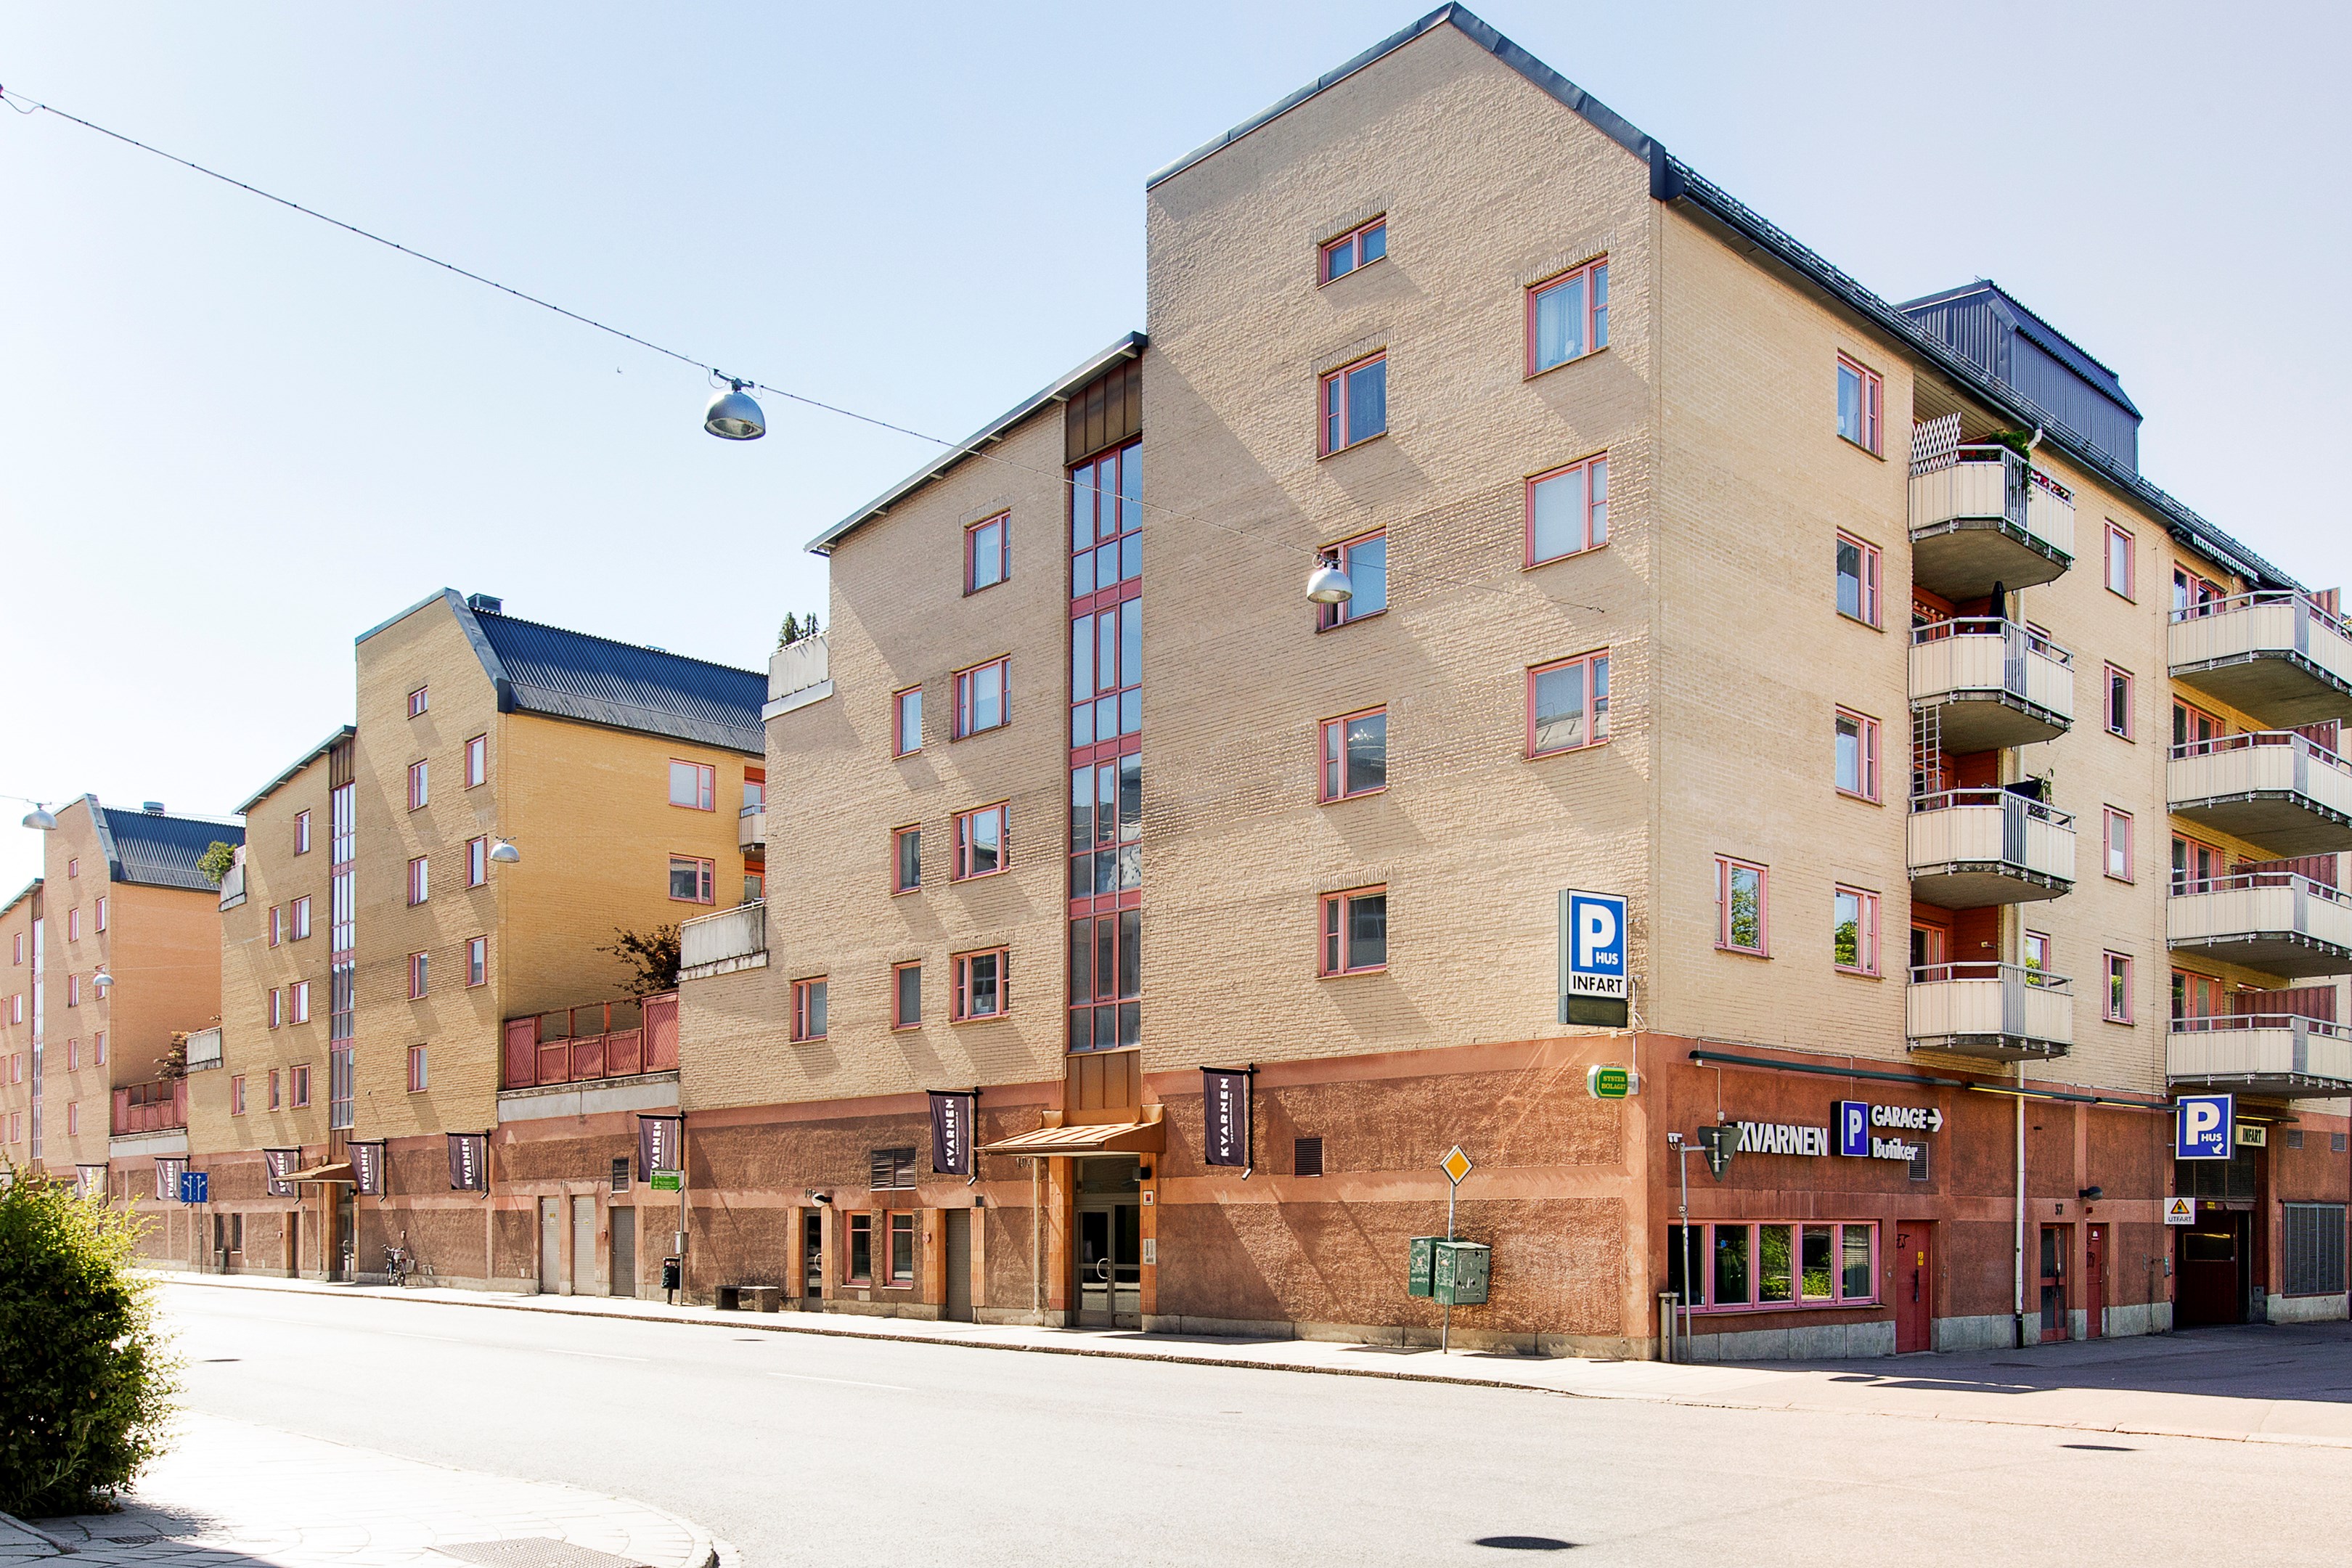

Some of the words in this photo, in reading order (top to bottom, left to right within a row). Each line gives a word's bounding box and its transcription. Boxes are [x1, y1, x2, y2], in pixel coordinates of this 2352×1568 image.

[1579, 902, 1617, 968] P
[1595, 951, 1619, 965] HUS
[1572, 975, 1623, 993] INFART
[945, 1098, 955, 1167] KVARNEN
[1220, 1077, 1229, 1157] KVARNEN
[1848, 1108, 1863, 1147] P
[1871, 1104, 1927, 1130] GARAGE
[2186, 1101, 2221, 1146] P
[2201, 1132, 2223, 1142] HUS
[2242, 1127, 2262, 1144] INFART
[651, 1121, 662, 1169] VARNEN
[1736, 1121, 1828, 1157] KVARNEN
[1872, 1136, 1919, 1161] Butiker
[277, 1152, 287, 1193] KVRNEN
[360, 1146, 370, 1191] KVARNEN
[460, 1138, 473, 1185] KVARNEN
